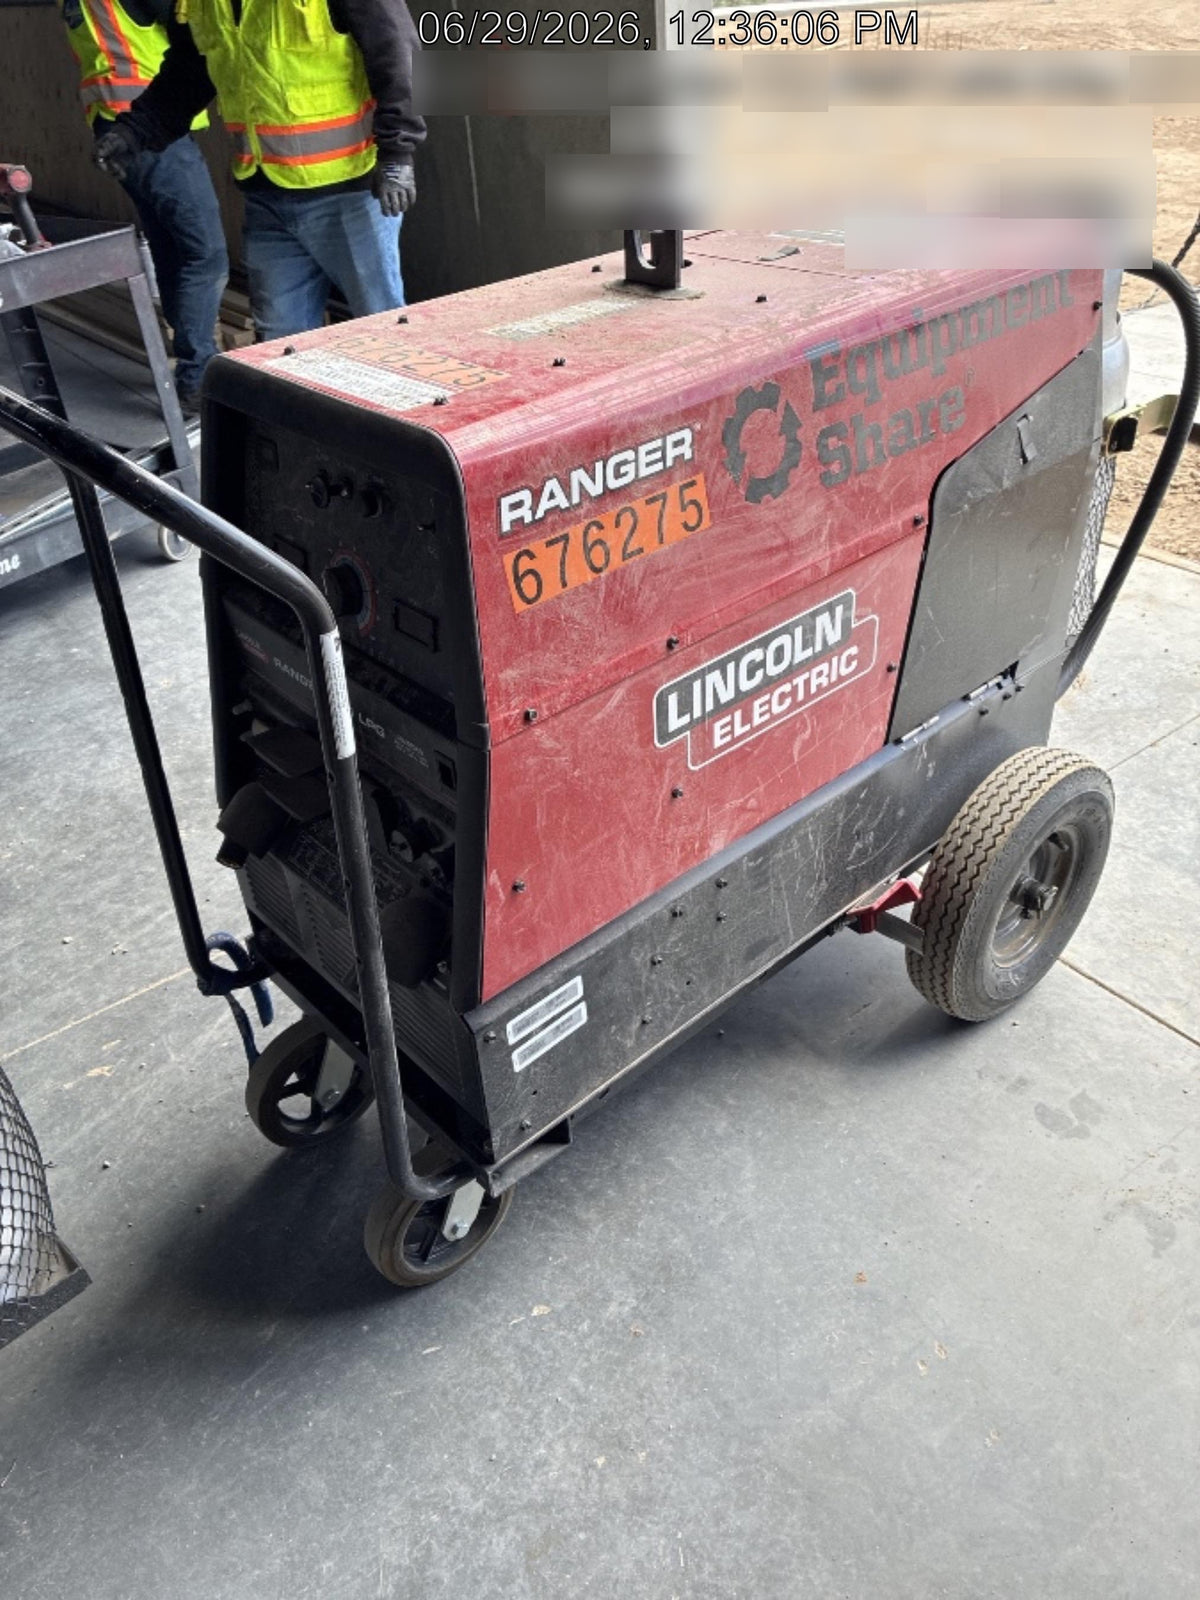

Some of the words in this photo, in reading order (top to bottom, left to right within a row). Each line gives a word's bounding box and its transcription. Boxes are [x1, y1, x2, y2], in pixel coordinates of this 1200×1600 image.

[802, 269, 1075, 413] Equipment
[500, 427, 694, 534] RANGER
[815, 384, 967, 488] Share
[511, 479, 704, 606] 676275
[667, 603, 845, 734] LINCOLN
[712, 644, 860, 750] ELECTRIC
